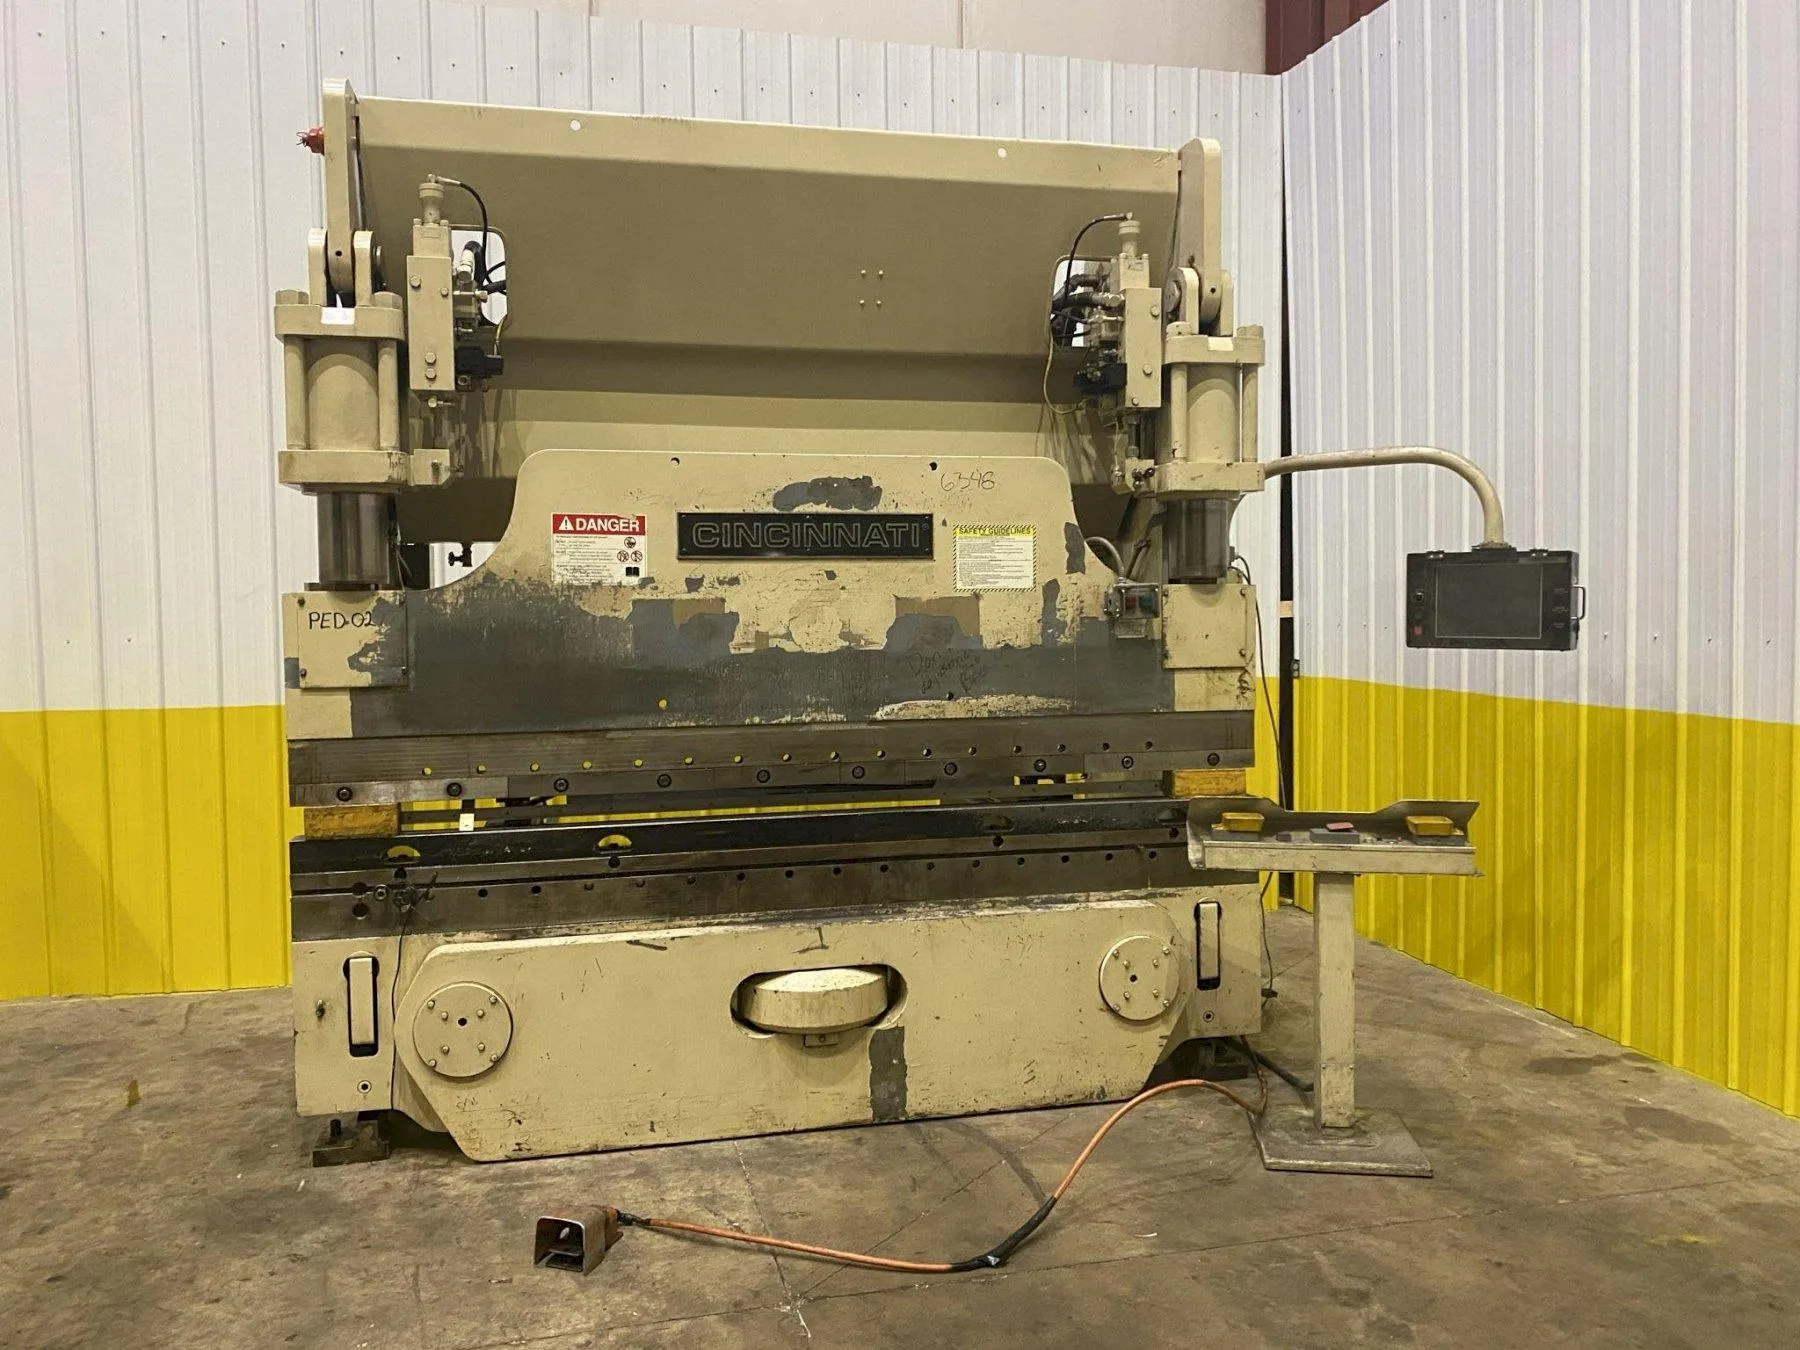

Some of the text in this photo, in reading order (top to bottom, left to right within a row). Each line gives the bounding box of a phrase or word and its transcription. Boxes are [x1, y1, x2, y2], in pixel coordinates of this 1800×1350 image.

[575, 518, 640, 532] DANGER
[959, 527, 1031, 536] SAFETY GUIDELINES
[693, 522, 920, 548] CINCINNATI
[308, 611, 377, 630] PED-02
